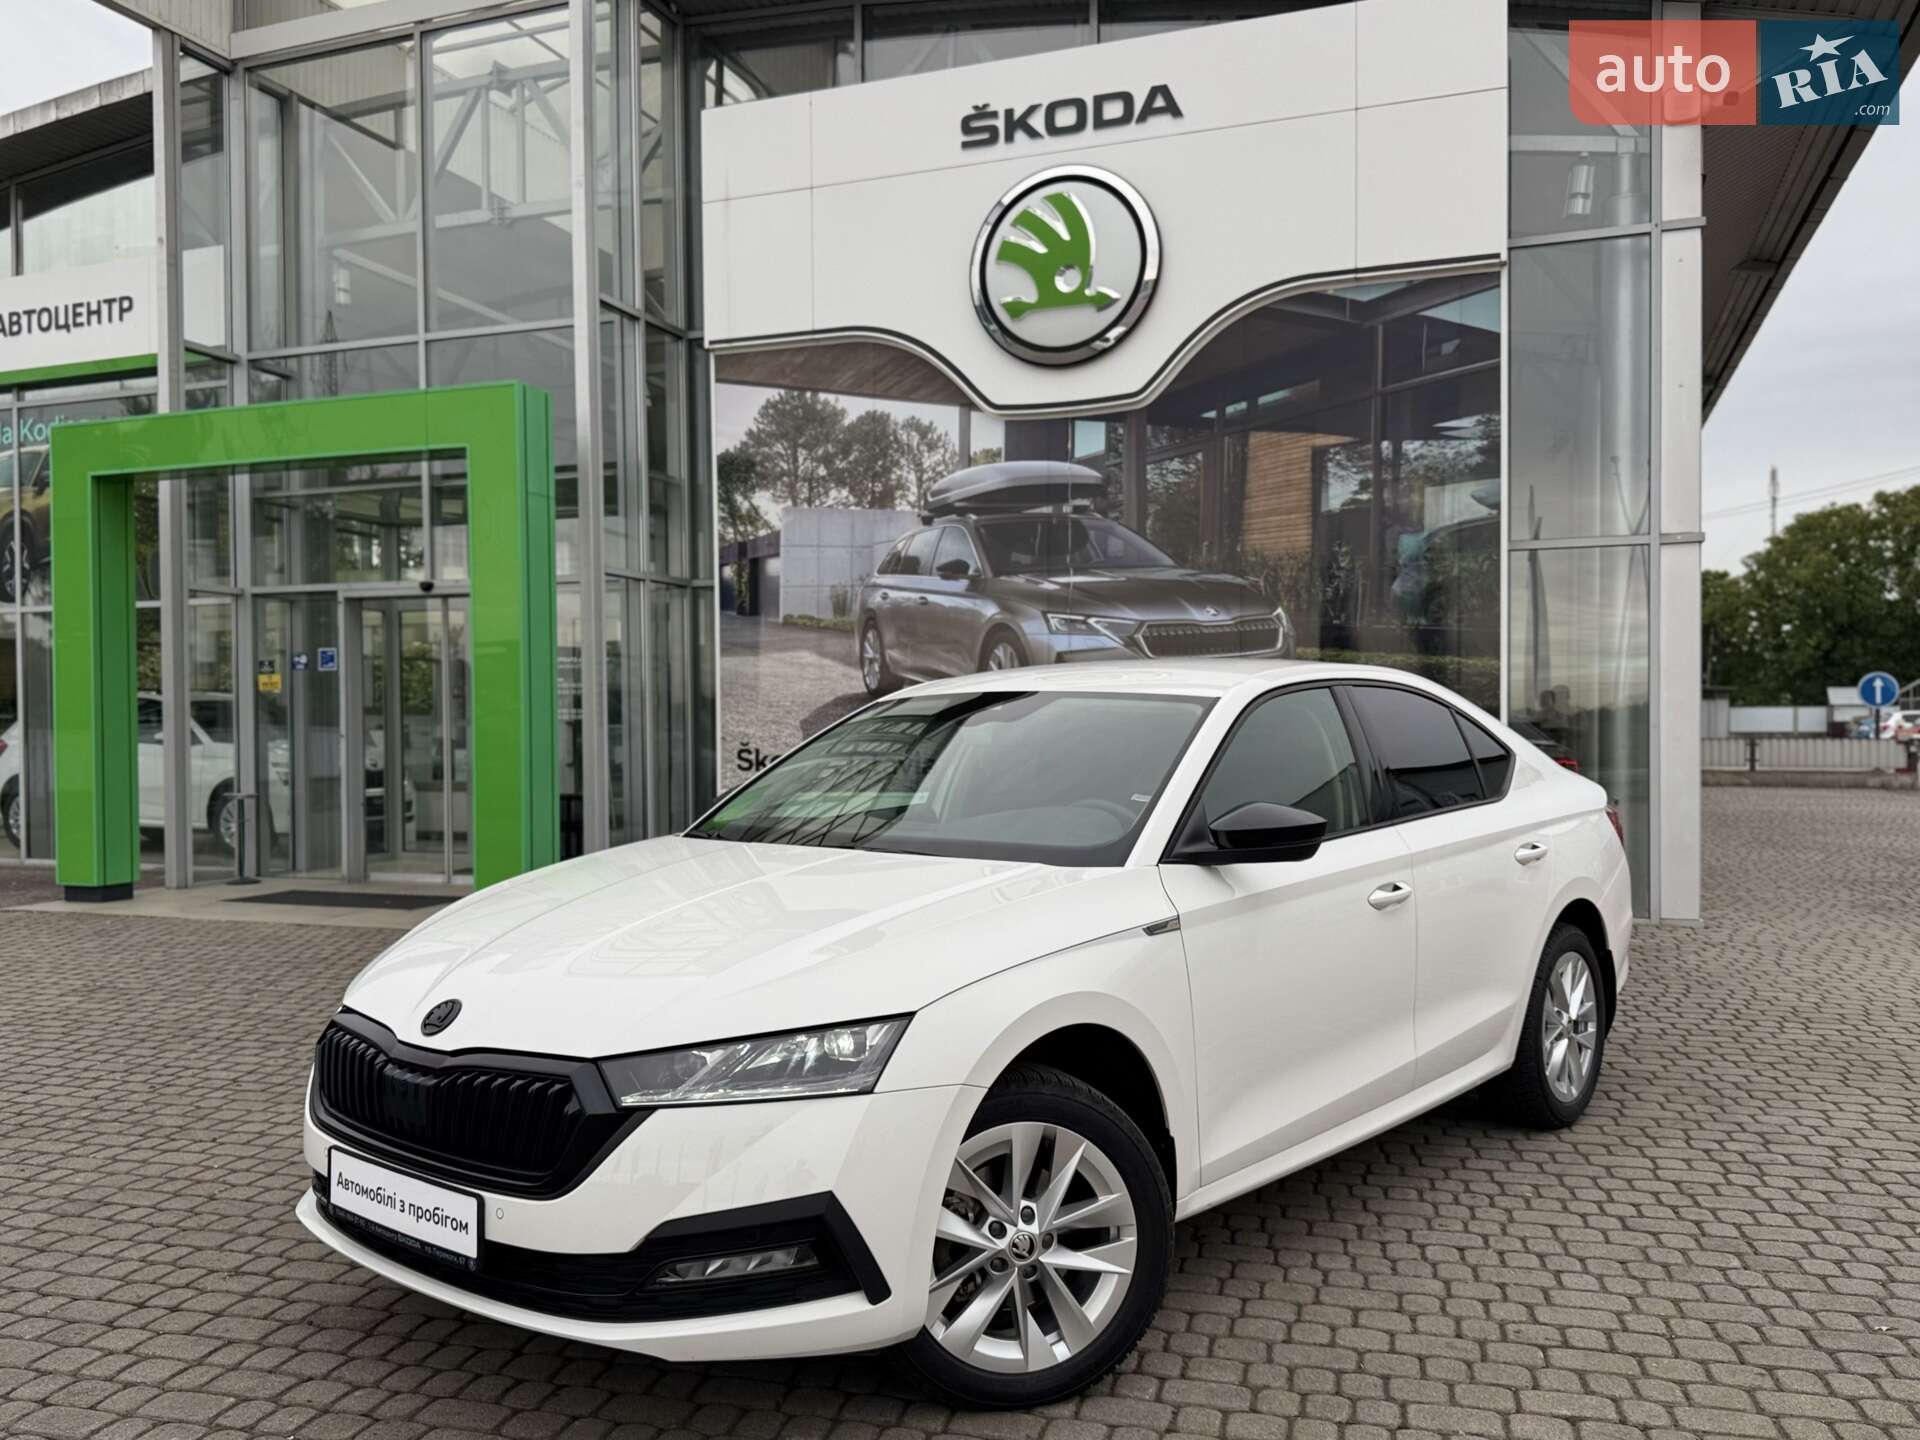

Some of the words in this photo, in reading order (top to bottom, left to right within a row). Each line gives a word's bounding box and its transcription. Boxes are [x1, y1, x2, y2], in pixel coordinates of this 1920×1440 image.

[961, 84, 1184, 150] ŠKODA
[337, 1171, 397, 1209] Автомобілі
[399, 1199, 405, 1213] з
[408, 1203, 469, 1235] пробігом
